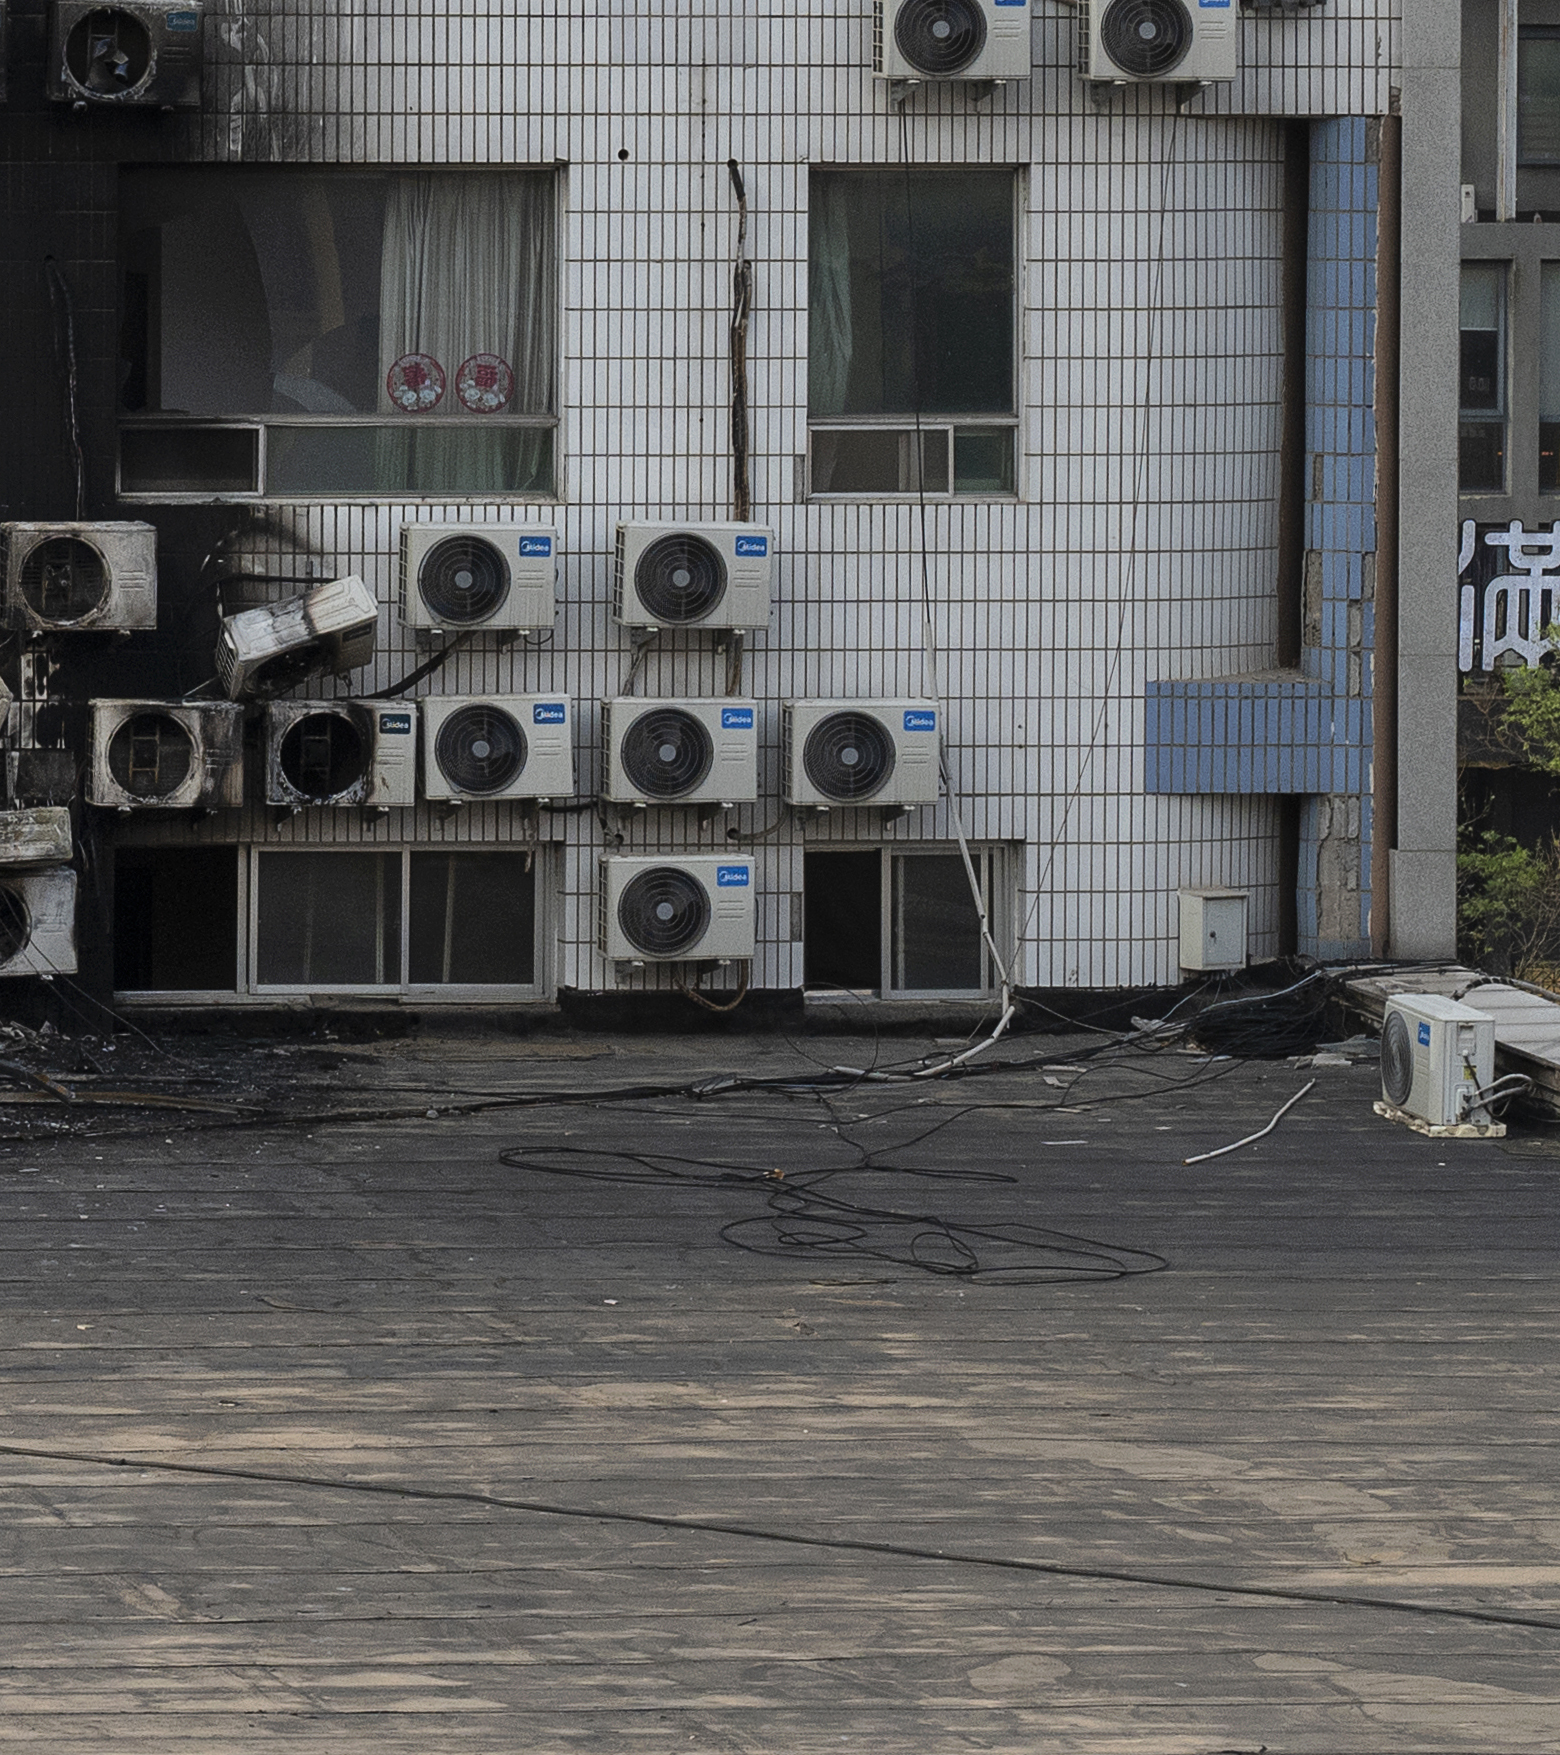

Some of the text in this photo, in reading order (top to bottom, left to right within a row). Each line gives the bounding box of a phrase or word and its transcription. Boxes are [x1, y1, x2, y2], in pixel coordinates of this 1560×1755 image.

[521, 540, 549, 552] Midea
[735, 540, 765, 552] Midea
[535, 707, 563, 719] Midea
[723, 712, 752, 724] Midea
[381, 718, 409, 729] Midea
[905, 715, 933, 727] Midea
[719, 871, 747, 882] Midea
